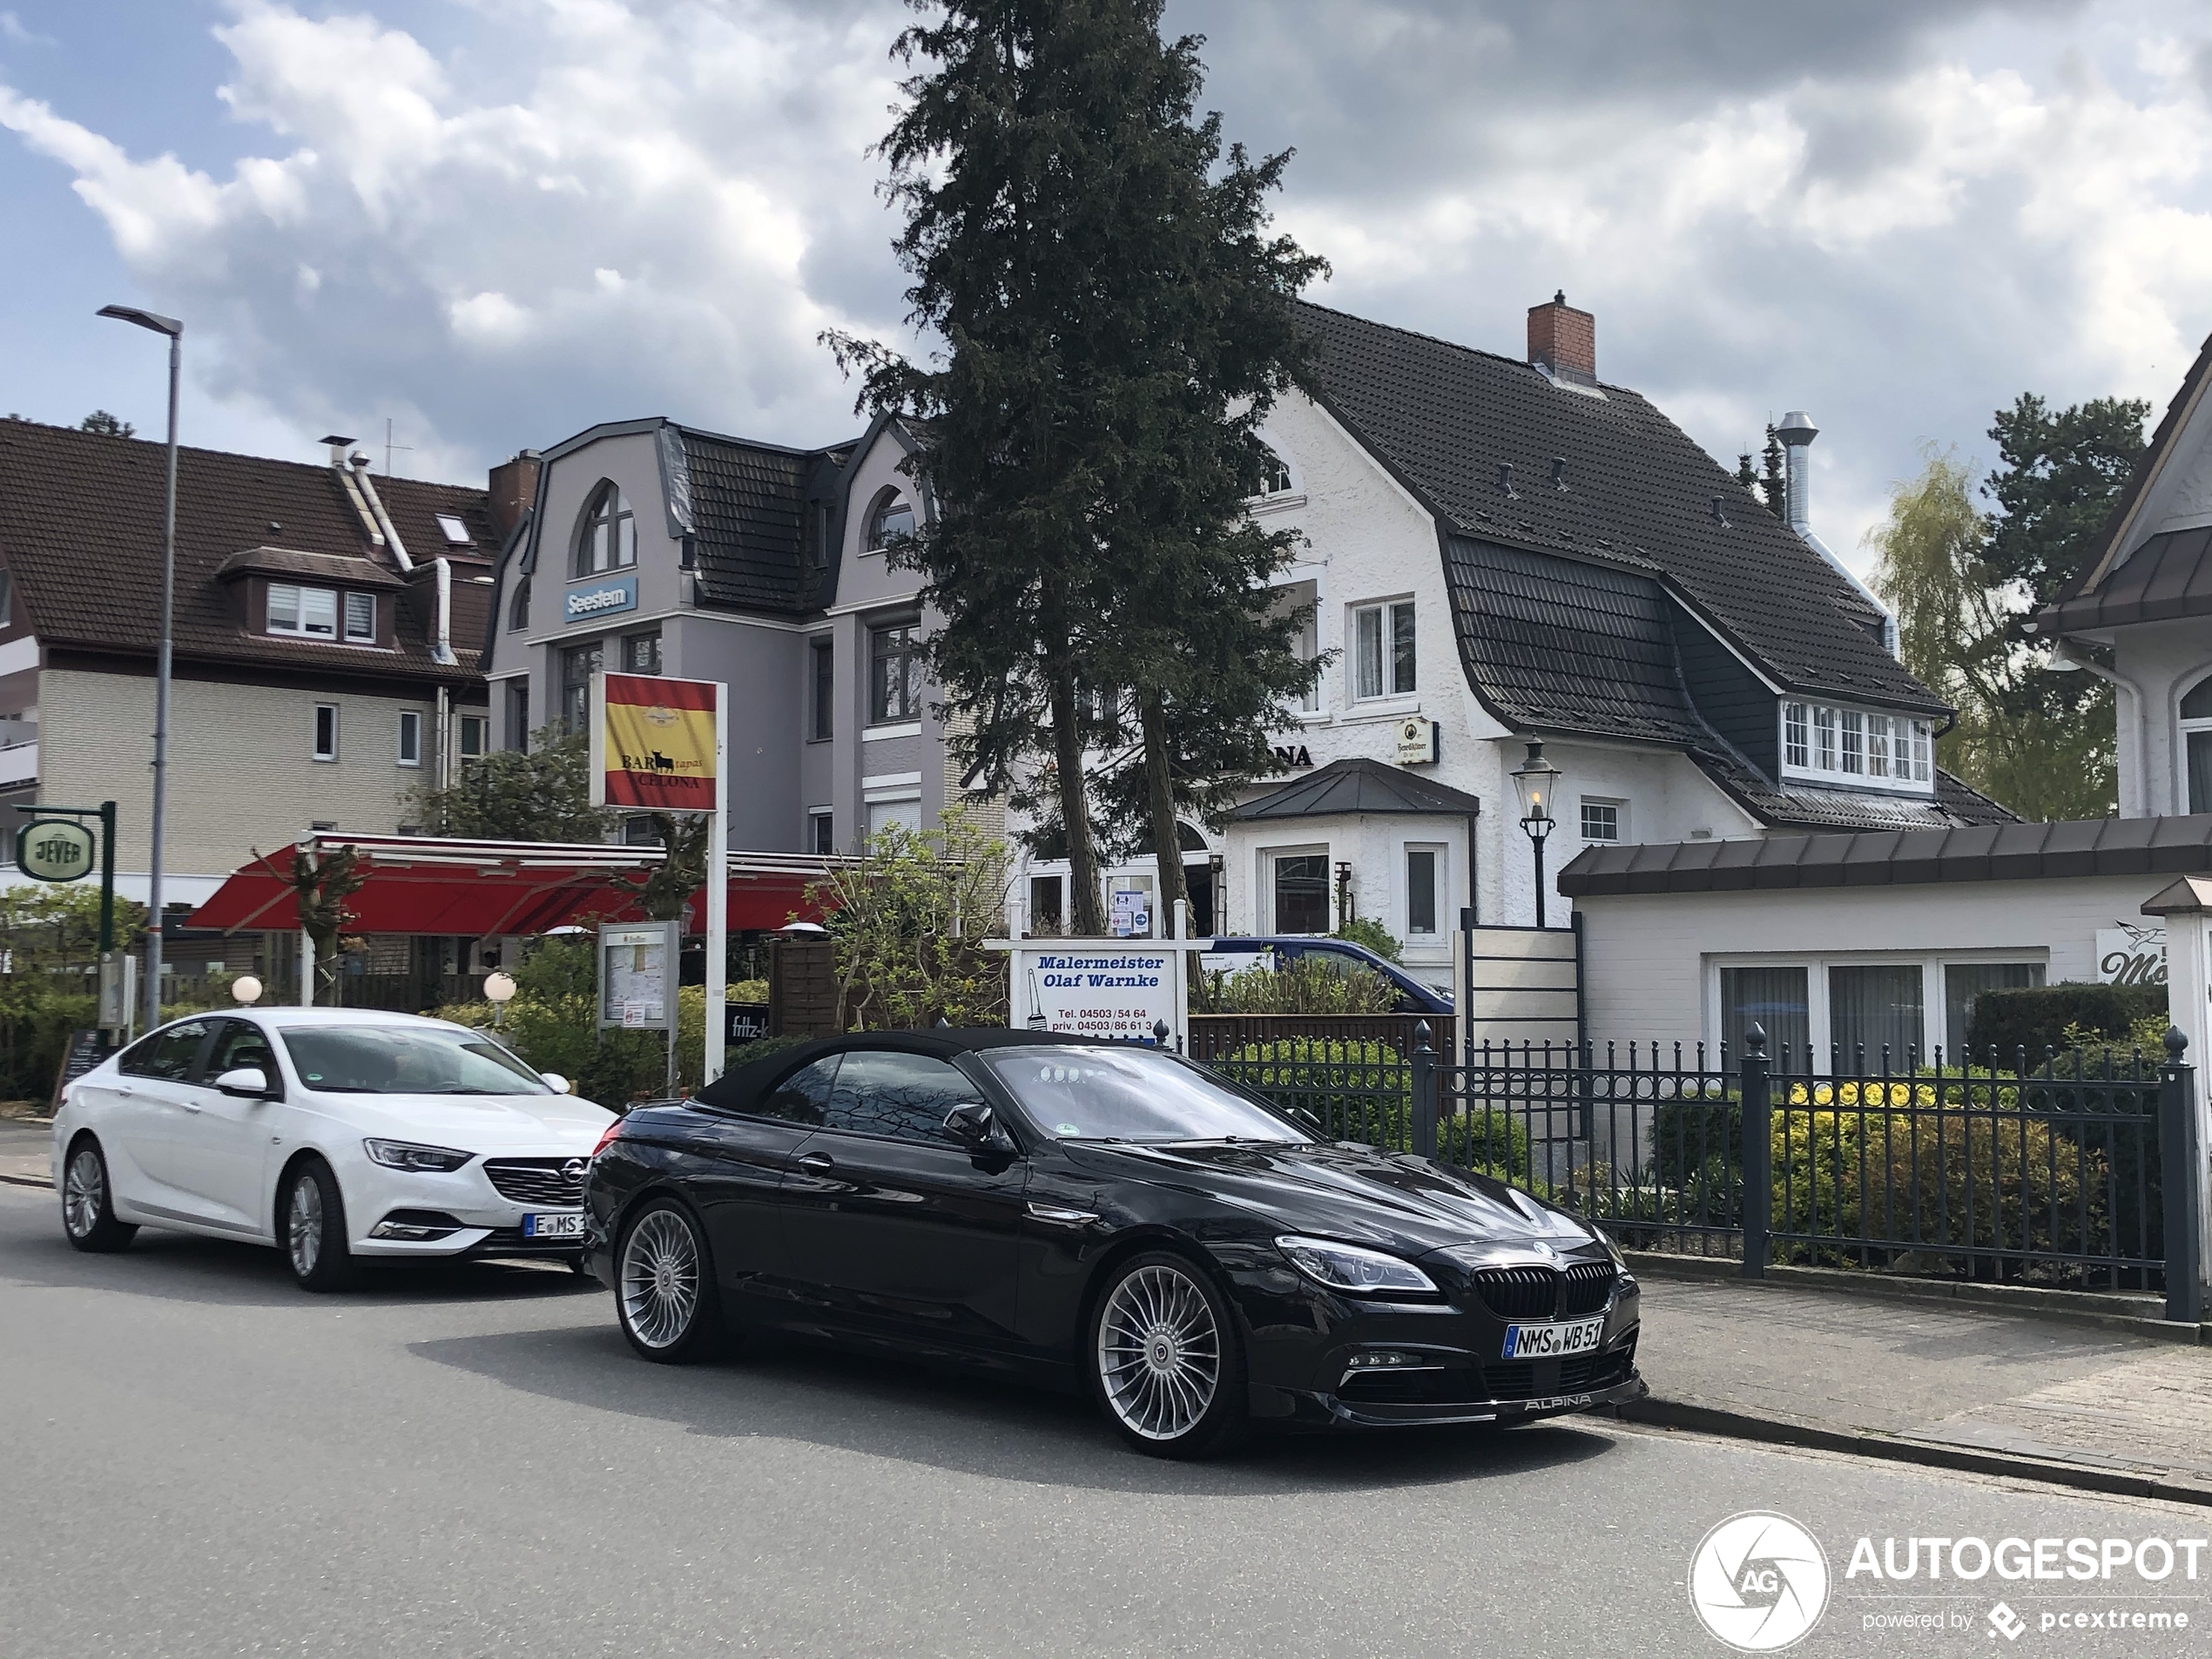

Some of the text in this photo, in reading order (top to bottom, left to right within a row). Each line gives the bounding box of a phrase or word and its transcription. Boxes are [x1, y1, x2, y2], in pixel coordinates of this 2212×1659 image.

[622, 755, 703, 771] BAR tapas
[639, 773, 699, 789] CELONA
[36, 840, 80, 864] JEVER
[1037, 956, 1164, 969] Malermeister
[1043, 974, 1159, 987] Olaf Warnke
[1058, 1009, 1076, 1018] Tel.
[1133, 1009, 1146, 1018] 64
[1052, 1022, 1075, 1032] priv.
[1130, 1022, 1142, 1030] 61
[1516, 1329, 1554, 1354] NMS
[1524, 1395, 1592, 1411] ALPINA
